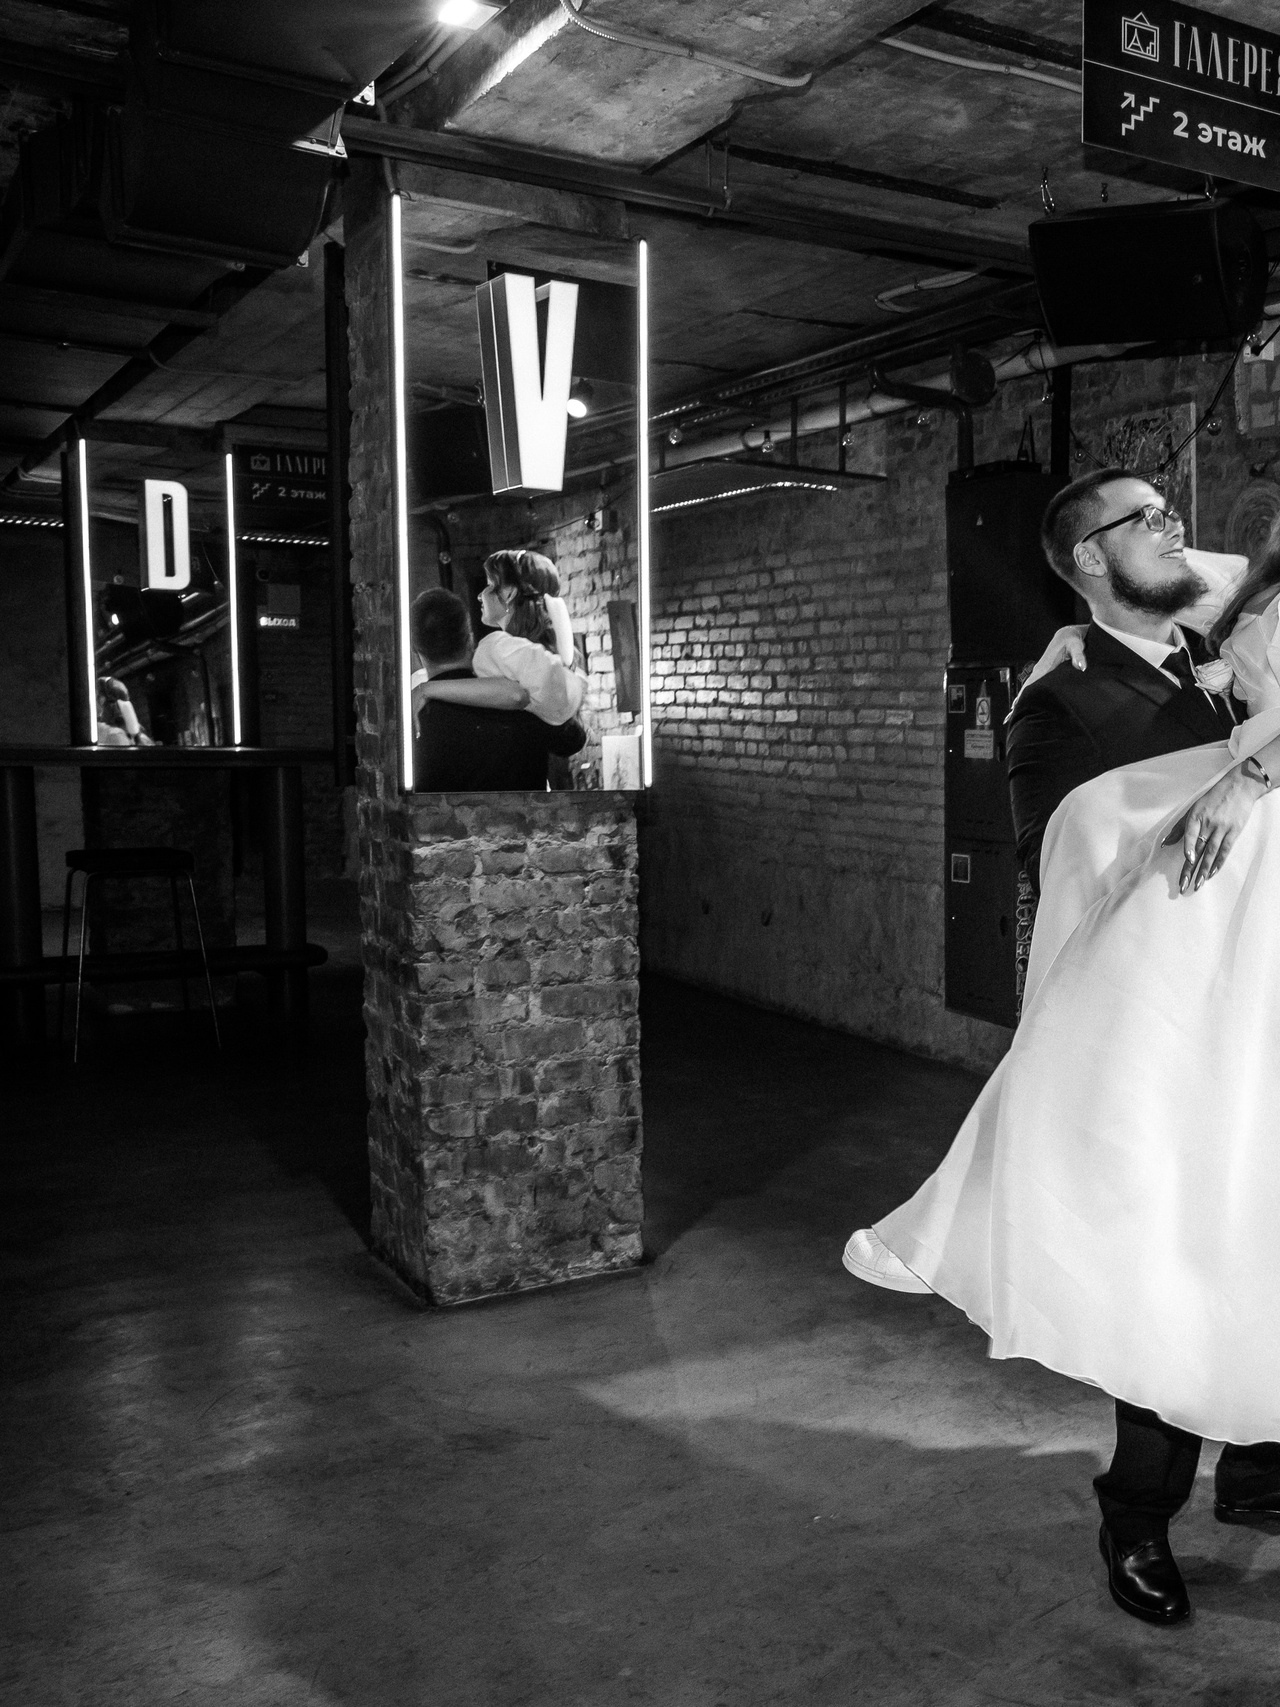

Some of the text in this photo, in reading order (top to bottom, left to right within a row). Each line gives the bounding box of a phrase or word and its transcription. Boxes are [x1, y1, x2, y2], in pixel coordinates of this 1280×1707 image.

[1173, 111, 1266, 158] 2 этаж
[505, 273, 579, 491] V
[278, 486, 326, 500] 2 этаж
[145, 479, 191, 590] D
